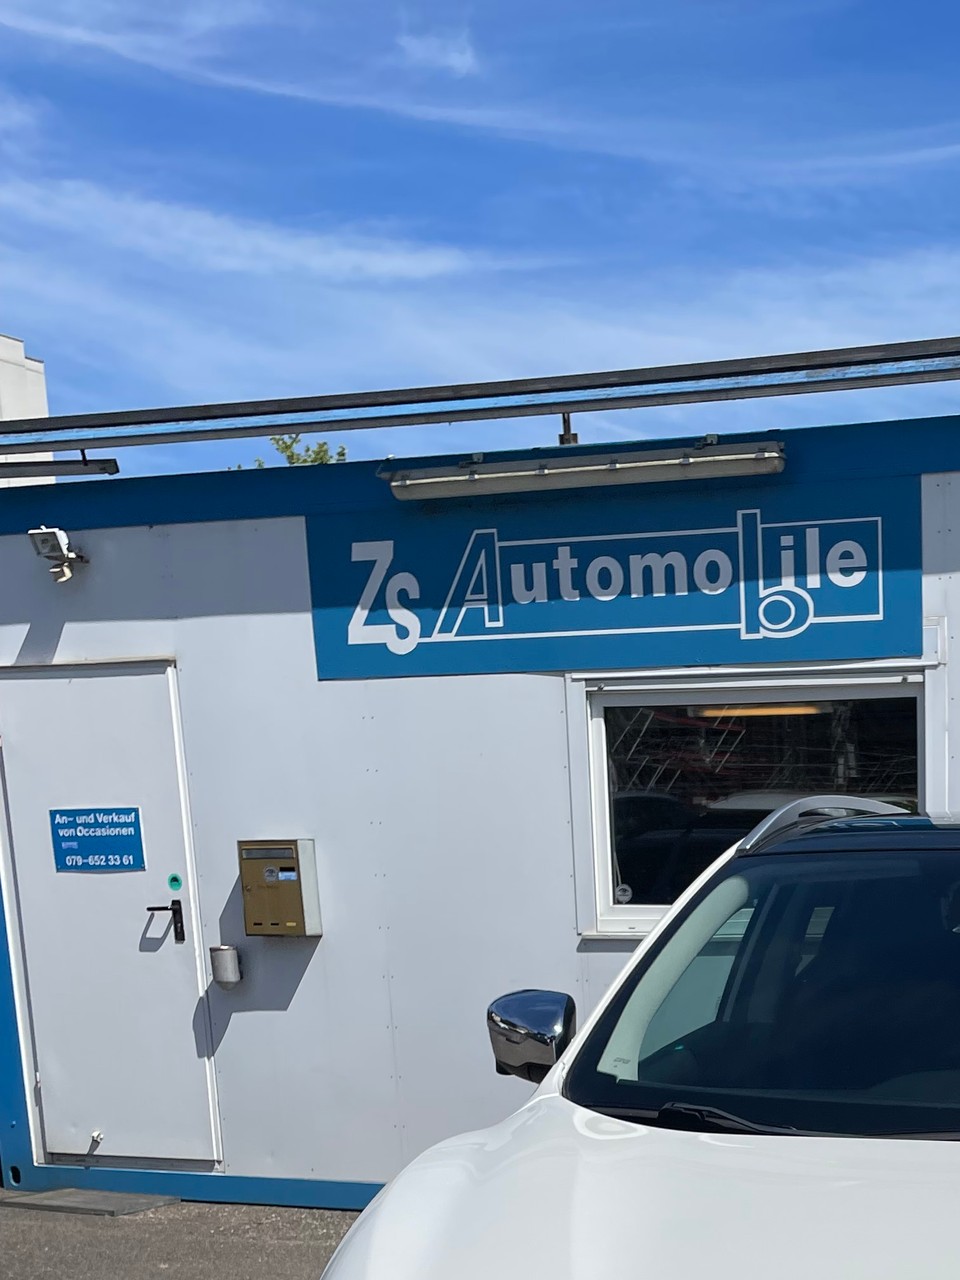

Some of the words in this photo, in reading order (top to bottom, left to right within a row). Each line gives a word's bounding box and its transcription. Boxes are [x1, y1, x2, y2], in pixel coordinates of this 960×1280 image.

[431, 508, 868, 640] Automobile
[76, 813, 94, 824] und
[96, 811, 135, 823] Verkauf
[58, 828, 75, 837] von
[76, 824, 135, 836] Occasionen
[108, 854, 121, 865] 33
[122, 854, 134, 865] 61
